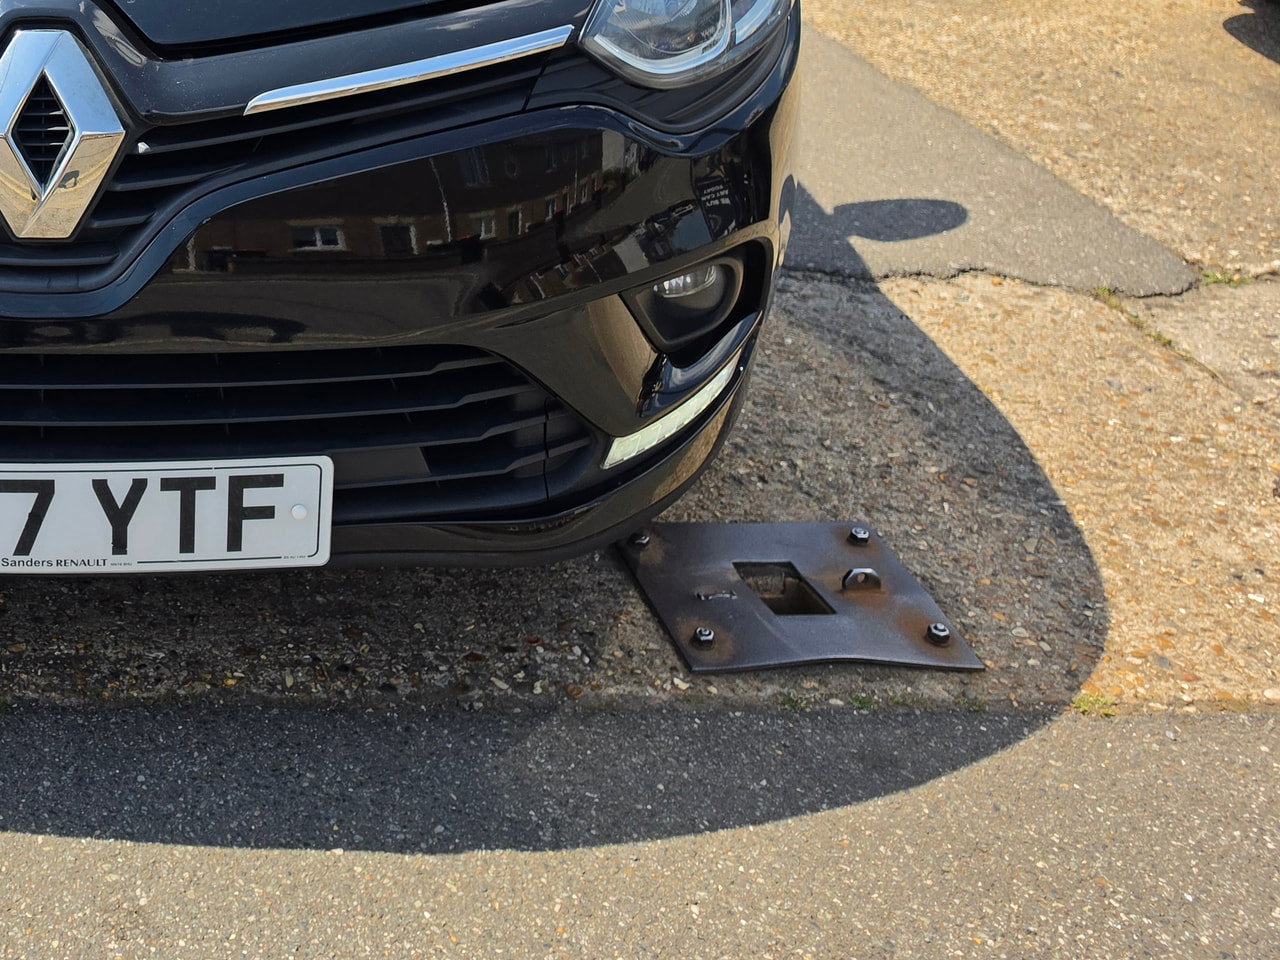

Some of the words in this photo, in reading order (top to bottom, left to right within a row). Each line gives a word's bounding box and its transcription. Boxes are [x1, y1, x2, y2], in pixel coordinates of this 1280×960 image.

[92, 473, 285, 556] YTF
[1, 557, 54, 567] Sanders
[56, 558, 108, 567] RENAULT
